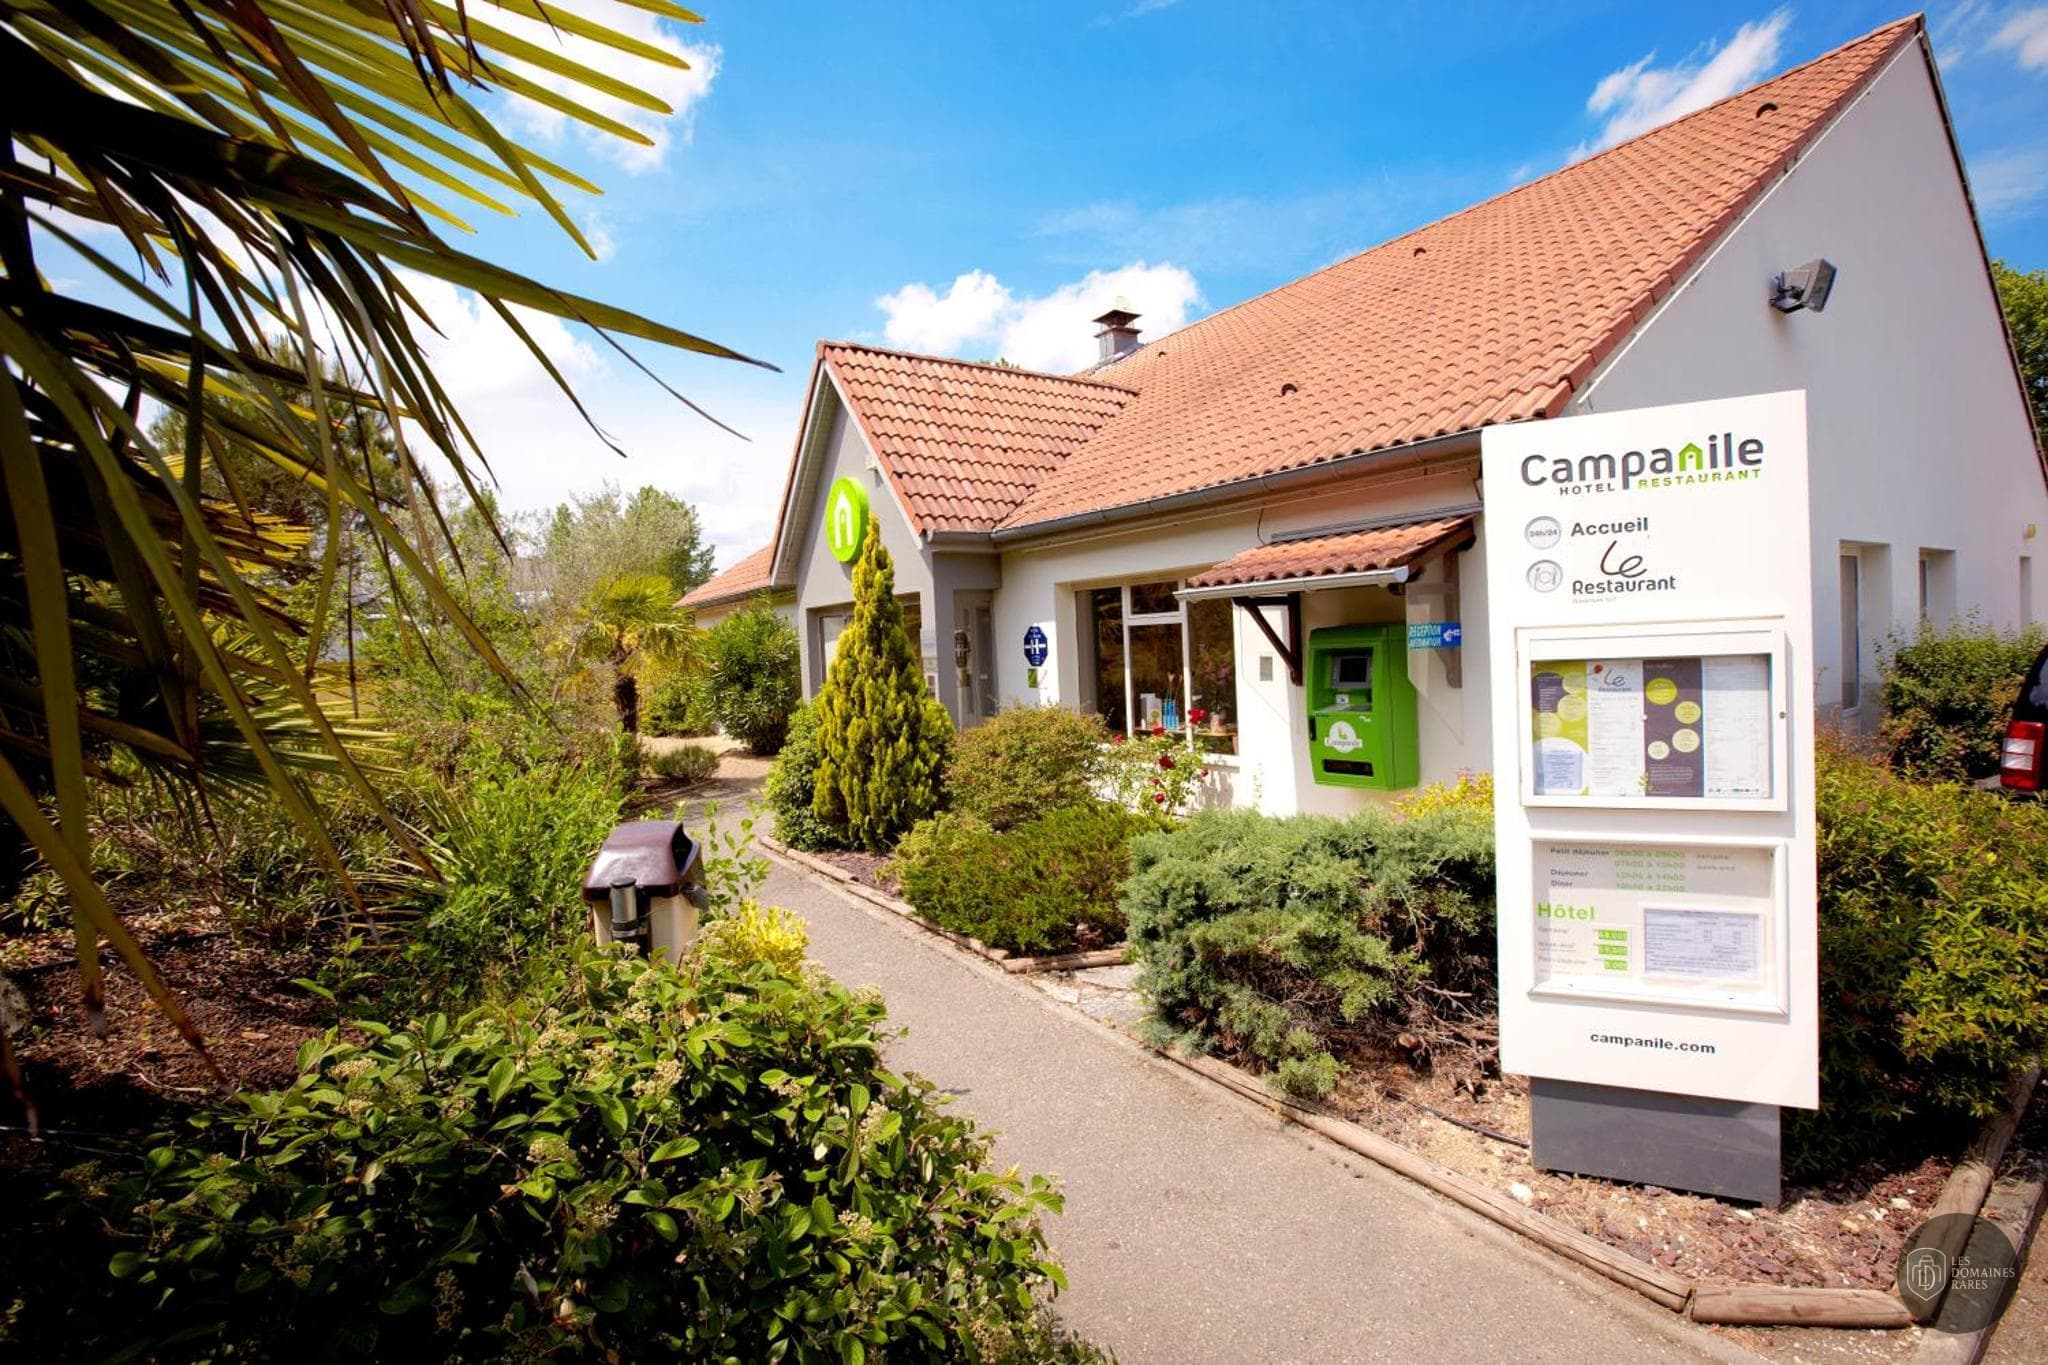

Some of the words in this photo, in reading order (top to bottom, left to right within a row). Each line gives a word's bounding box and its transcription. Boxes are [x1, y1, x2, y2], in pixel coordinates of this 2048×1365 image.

[1521, 432, 1764, 490] Campanile
[1559, 482, 1616, 496] HOTEL
[1638, 468, 1762, 489] RESTAURANT
[1570, 517, 1649, 537] Accueil
[1600, 540, 1648, 578] Le
[1572, 576, 1676, 595] Restaurant
[1537, 903, 1595, 920] Hôtel
[1590, 1033, 1716, 1054] campanile.com
